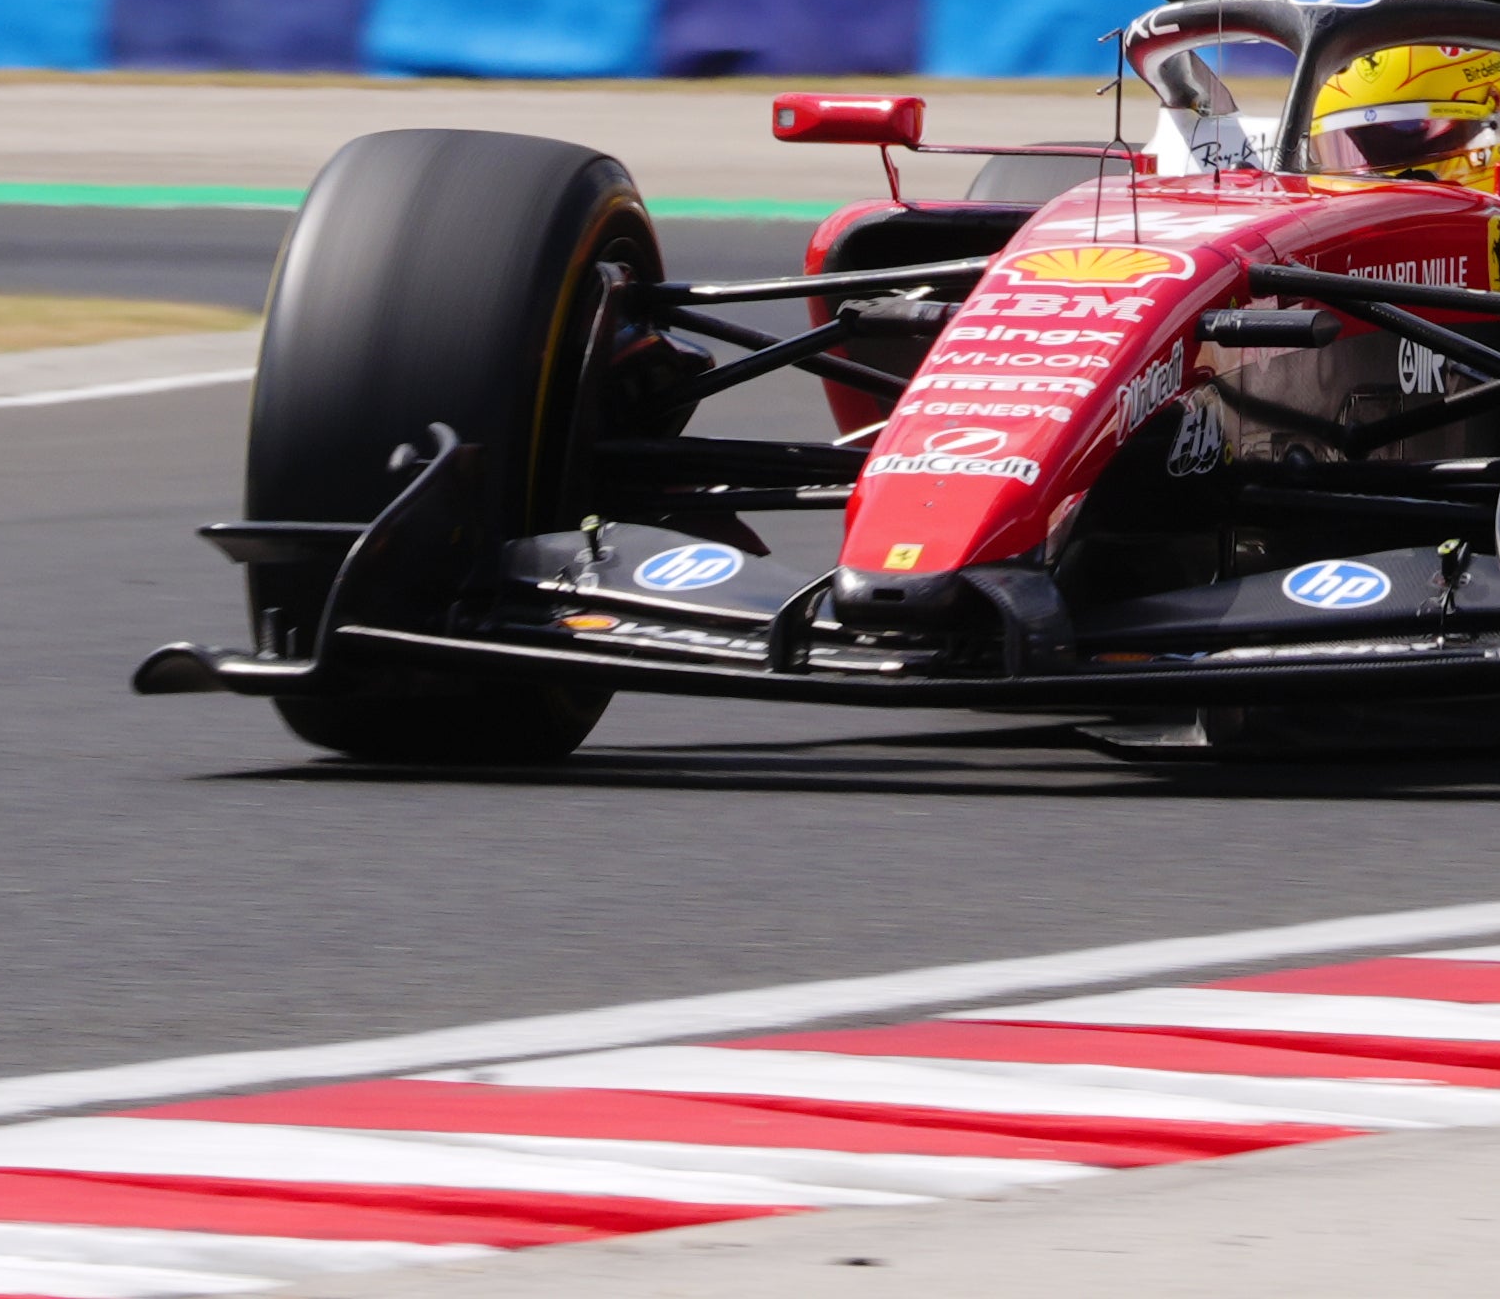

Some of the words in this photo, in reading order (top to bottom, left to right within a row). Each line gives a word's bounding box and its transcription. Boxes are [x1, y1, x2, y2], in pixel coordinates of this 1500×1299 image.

[1033, 211, 1260, 240] 44
[1422, 255, 1468, 287] MILLE
[960, 292, 1156, 324] IBM
[930, 350, 1111, 369] WHOOP
[908, 373, 1098, 399] PIRELLI
[923, 402, 1073, 423] GENESYS
[1171, 402, 1222, 463] FIA
[863, 453, 1041, 485] UniCredit
[645, 543, 736, 591] hp
[1296, 560, 1380, 608] hp
